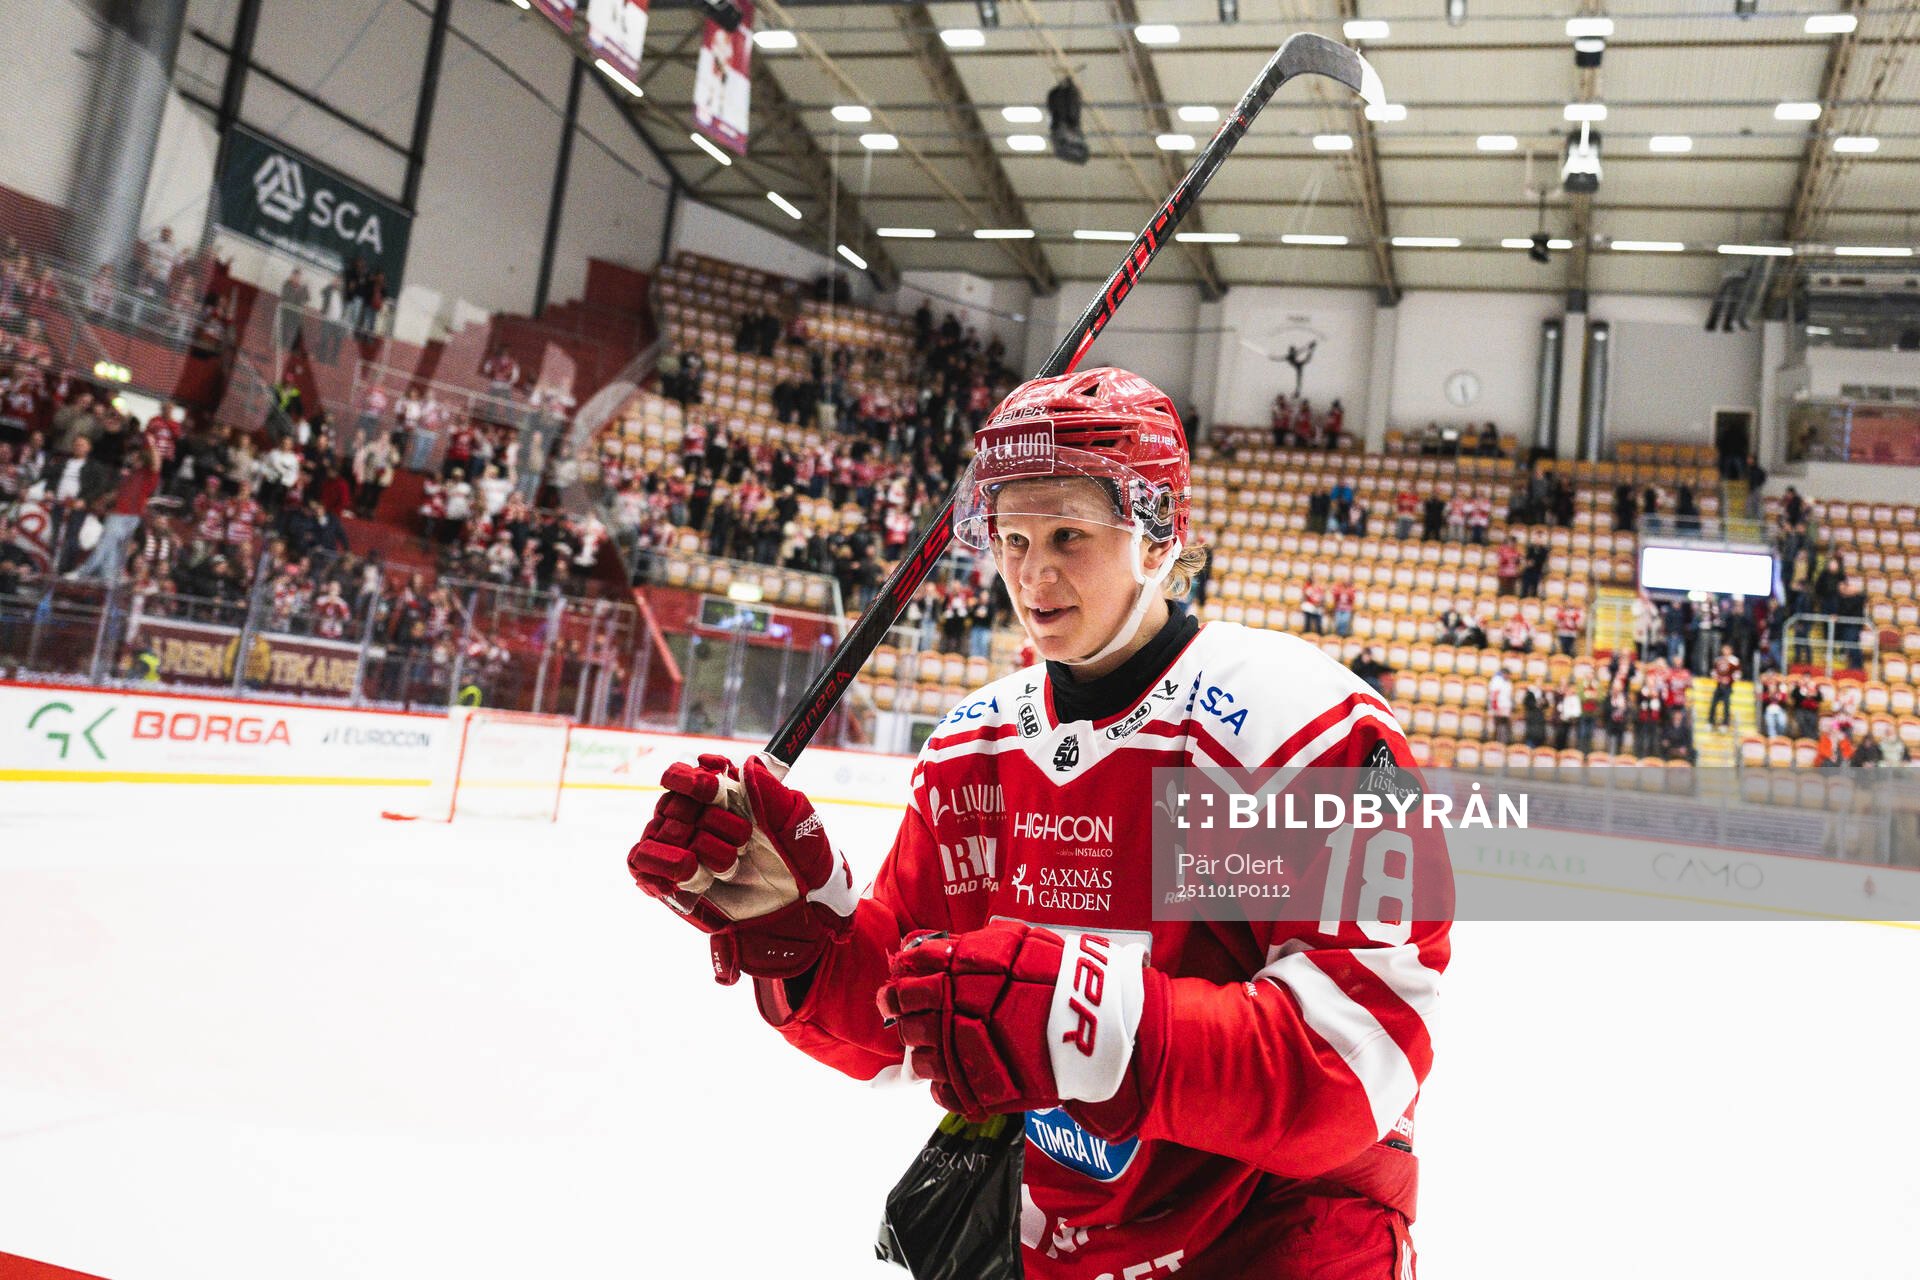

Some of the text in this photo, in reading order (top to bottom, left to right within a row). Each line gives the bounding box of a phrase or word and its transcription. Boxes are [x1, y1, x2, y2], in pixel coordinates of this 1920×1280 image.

[308, 189, 384, 255] SCA
[1020, 705, 1040, 736] EAB
[1110, 705, 1149, 738] EAB
[1200, 686, 1249, 737] SCA
[131, 711, 291, 746] BORGA
[342, 727, 431, 748] EUROCON
[1013, 812, 1113, 843] HIGHCON
[1075, 848, 1113, 858] INSTALCO
[1039, 867, 1113, 889] SAXNÄS
[1318, 823, 1415, 946] 18
[1039, 888, 1112, 912] GÅRDEN
[1031, 1117, 1092, 1165] TIMRÅ
[1089, 1135, 1114, 1174] IK
